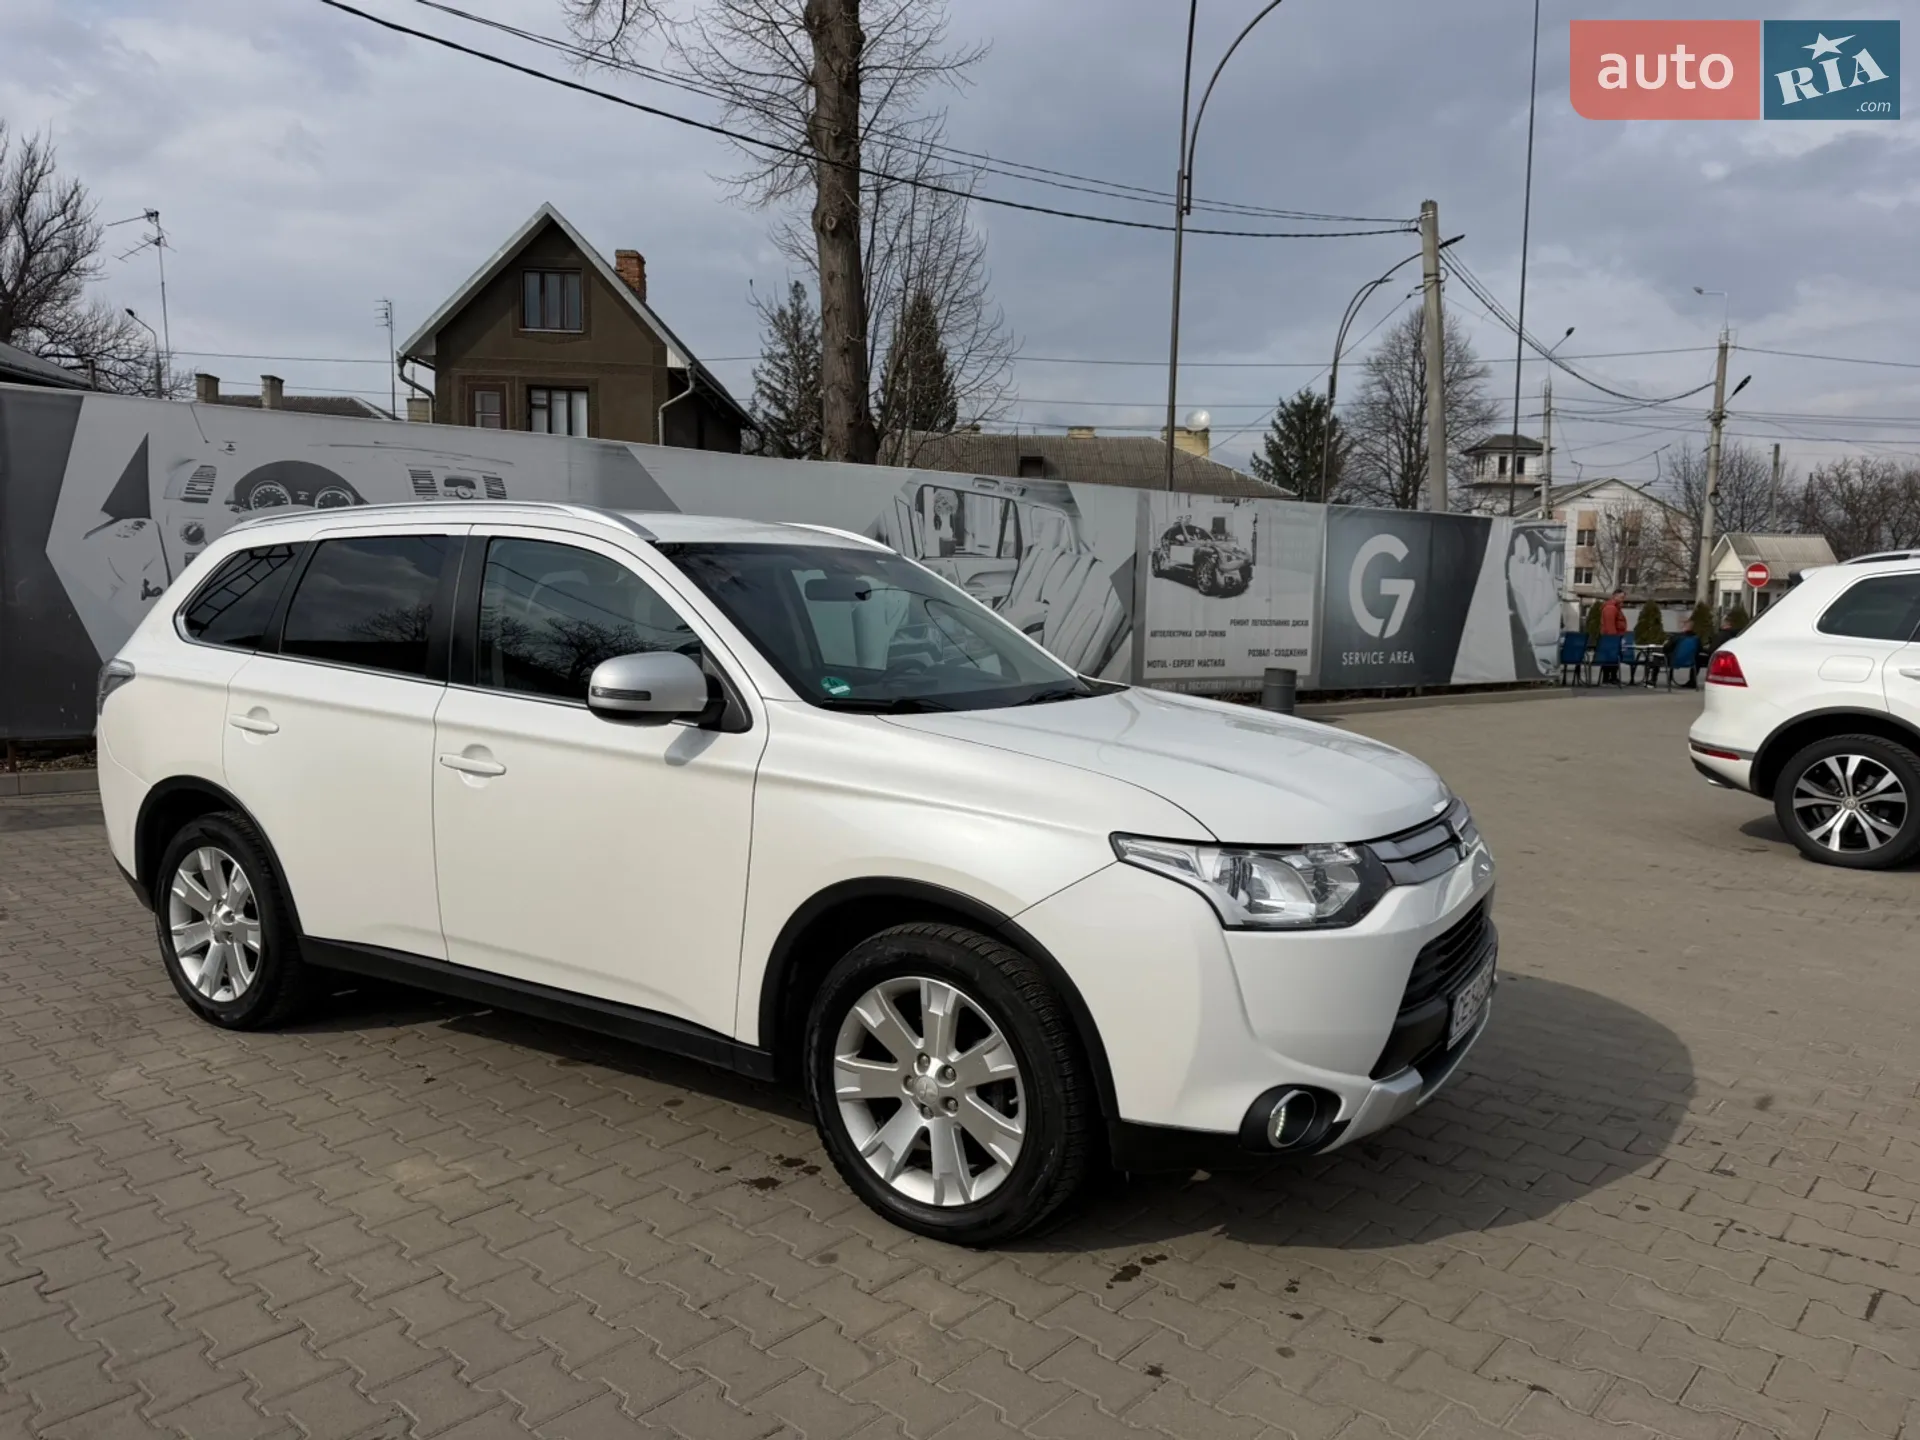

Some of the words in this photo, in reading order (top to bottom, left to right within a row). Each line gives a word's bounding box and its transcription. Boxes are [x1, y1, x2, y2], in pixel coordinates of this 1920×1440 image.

[1229, 618, 1249, 627] РЕМОНТ
[1342, 652, 1385, 666] SERVICE
[1389, 651, 1415, 664] AREA
[1146, 659, 1168, 669] MOTUL
[1172, 659, 1195, 668] EXPERT
